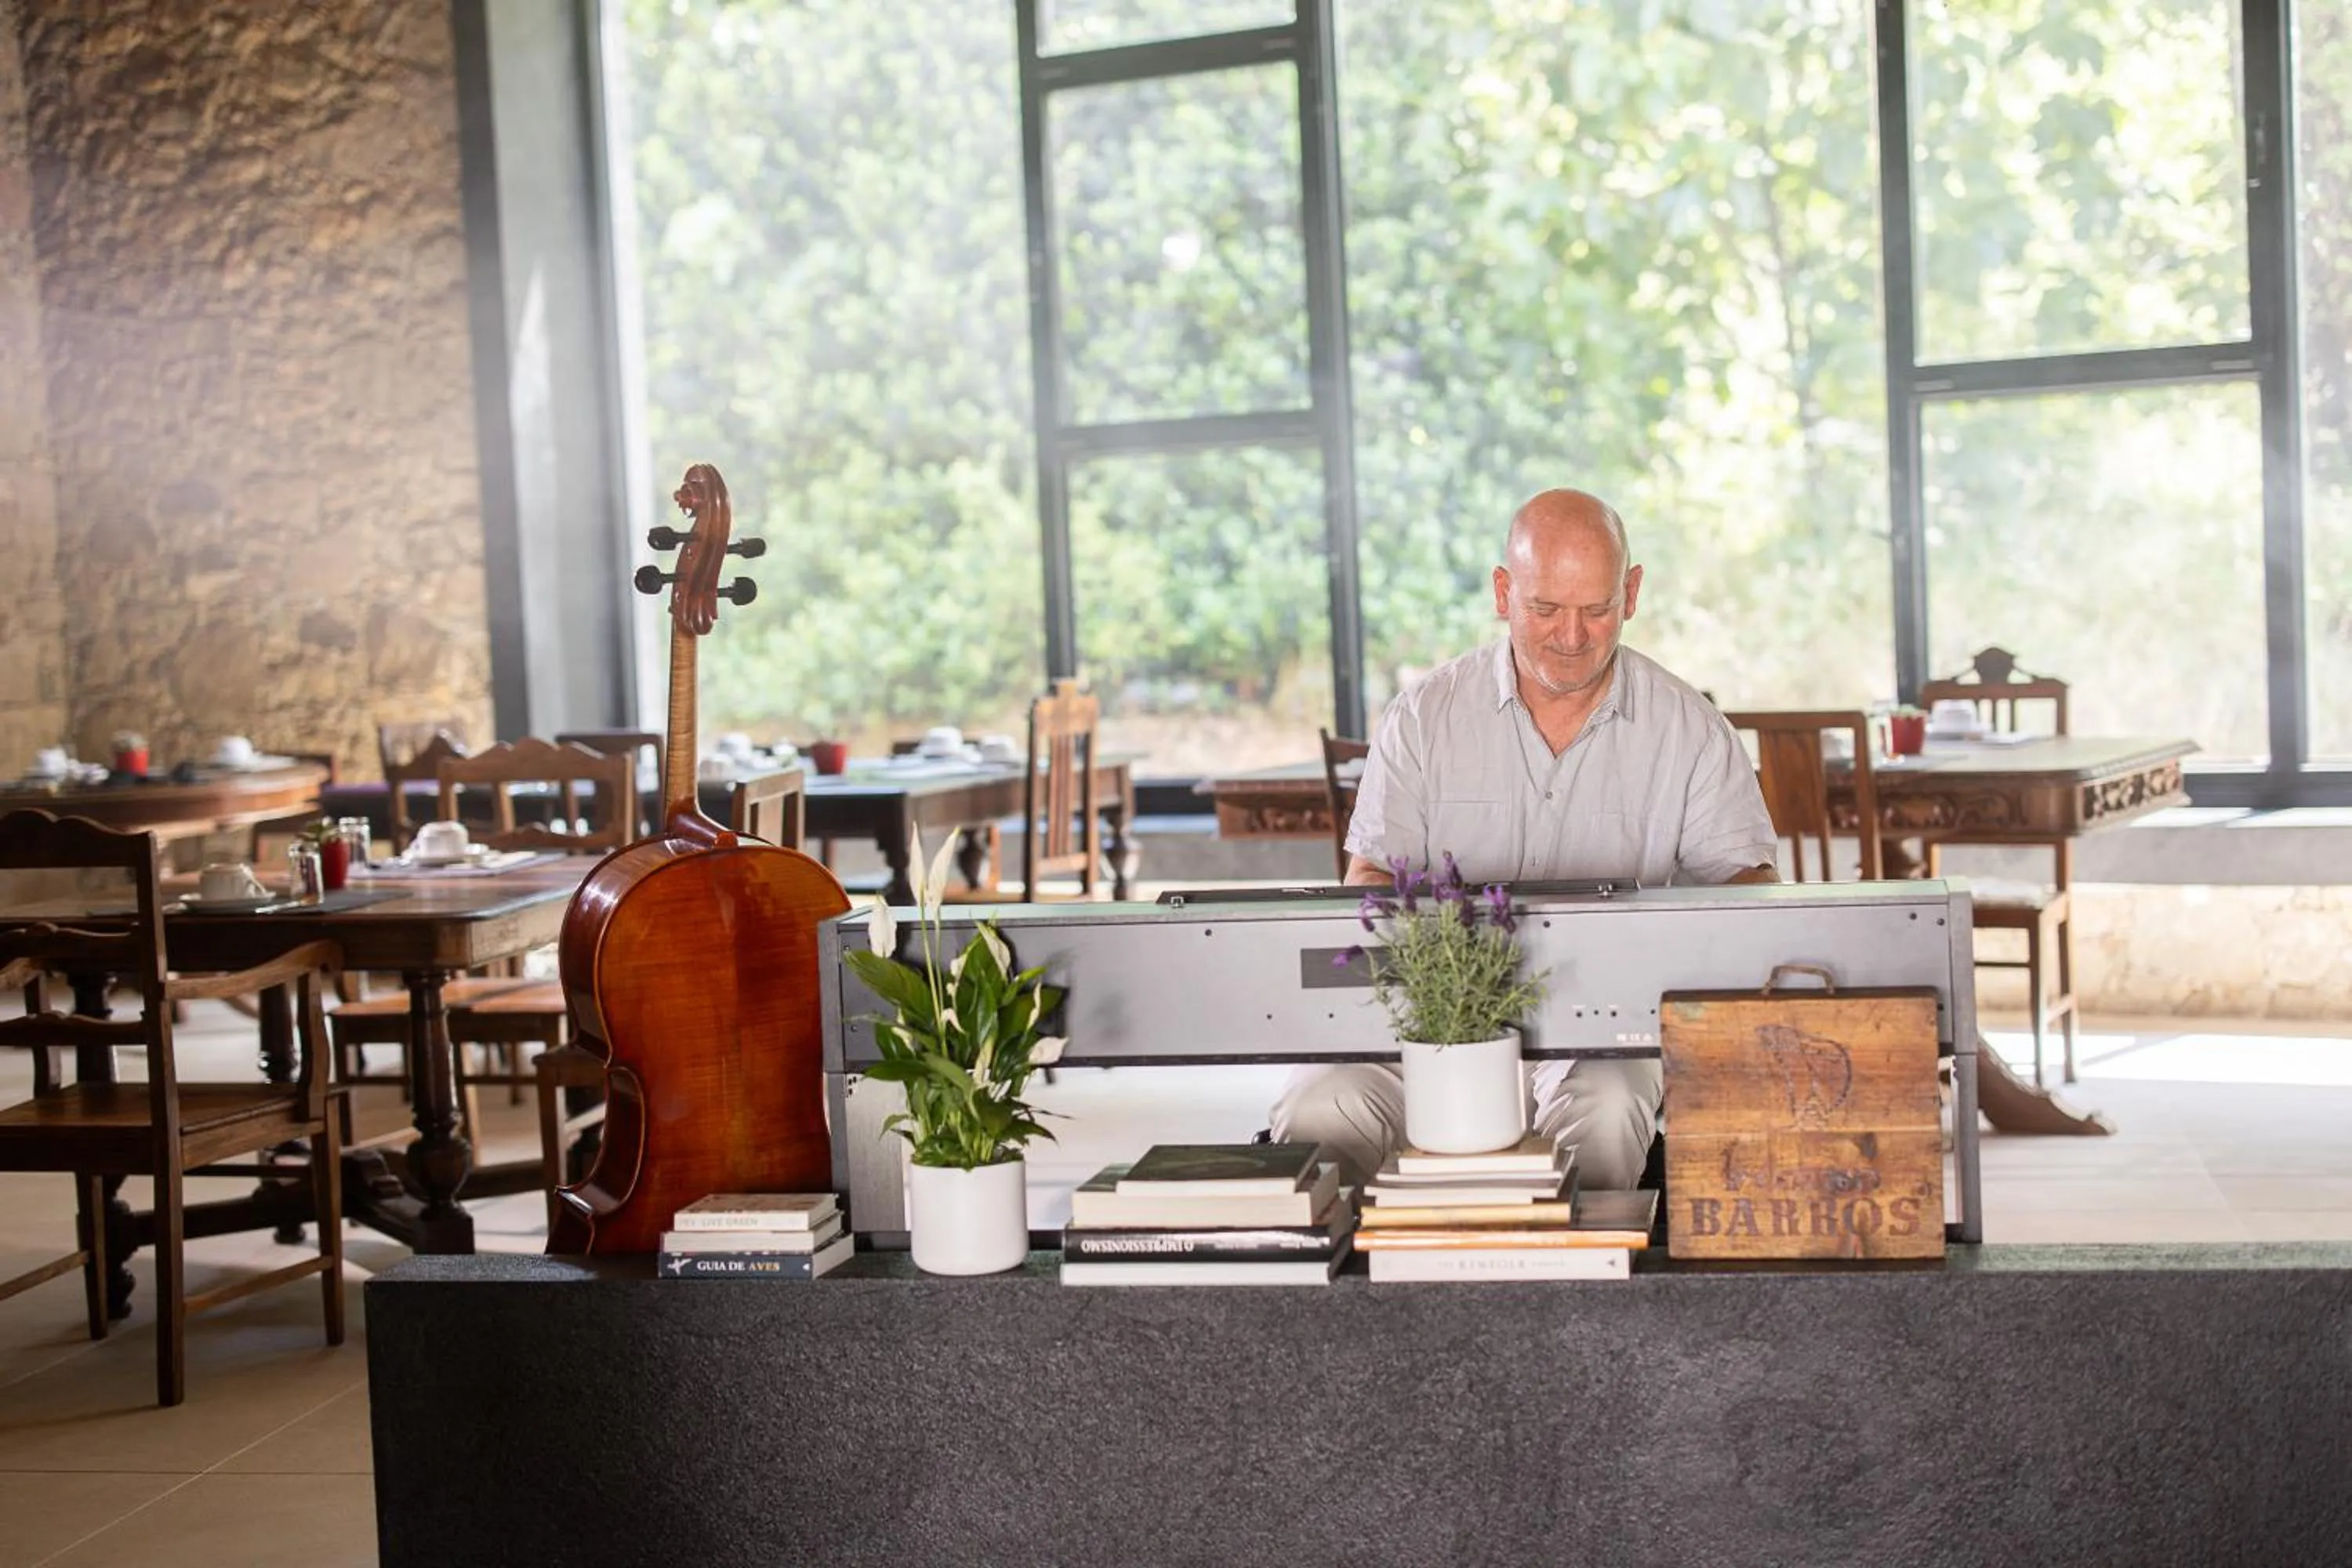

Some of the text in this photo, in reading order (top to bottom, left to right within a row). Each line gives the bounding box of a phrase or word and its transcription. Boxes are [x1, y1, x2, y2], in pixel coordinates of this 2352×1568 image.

[1690, 1196, 1921, 1237] BARROS
[697, 1260, 781, 1271] GUIA DE AVES
